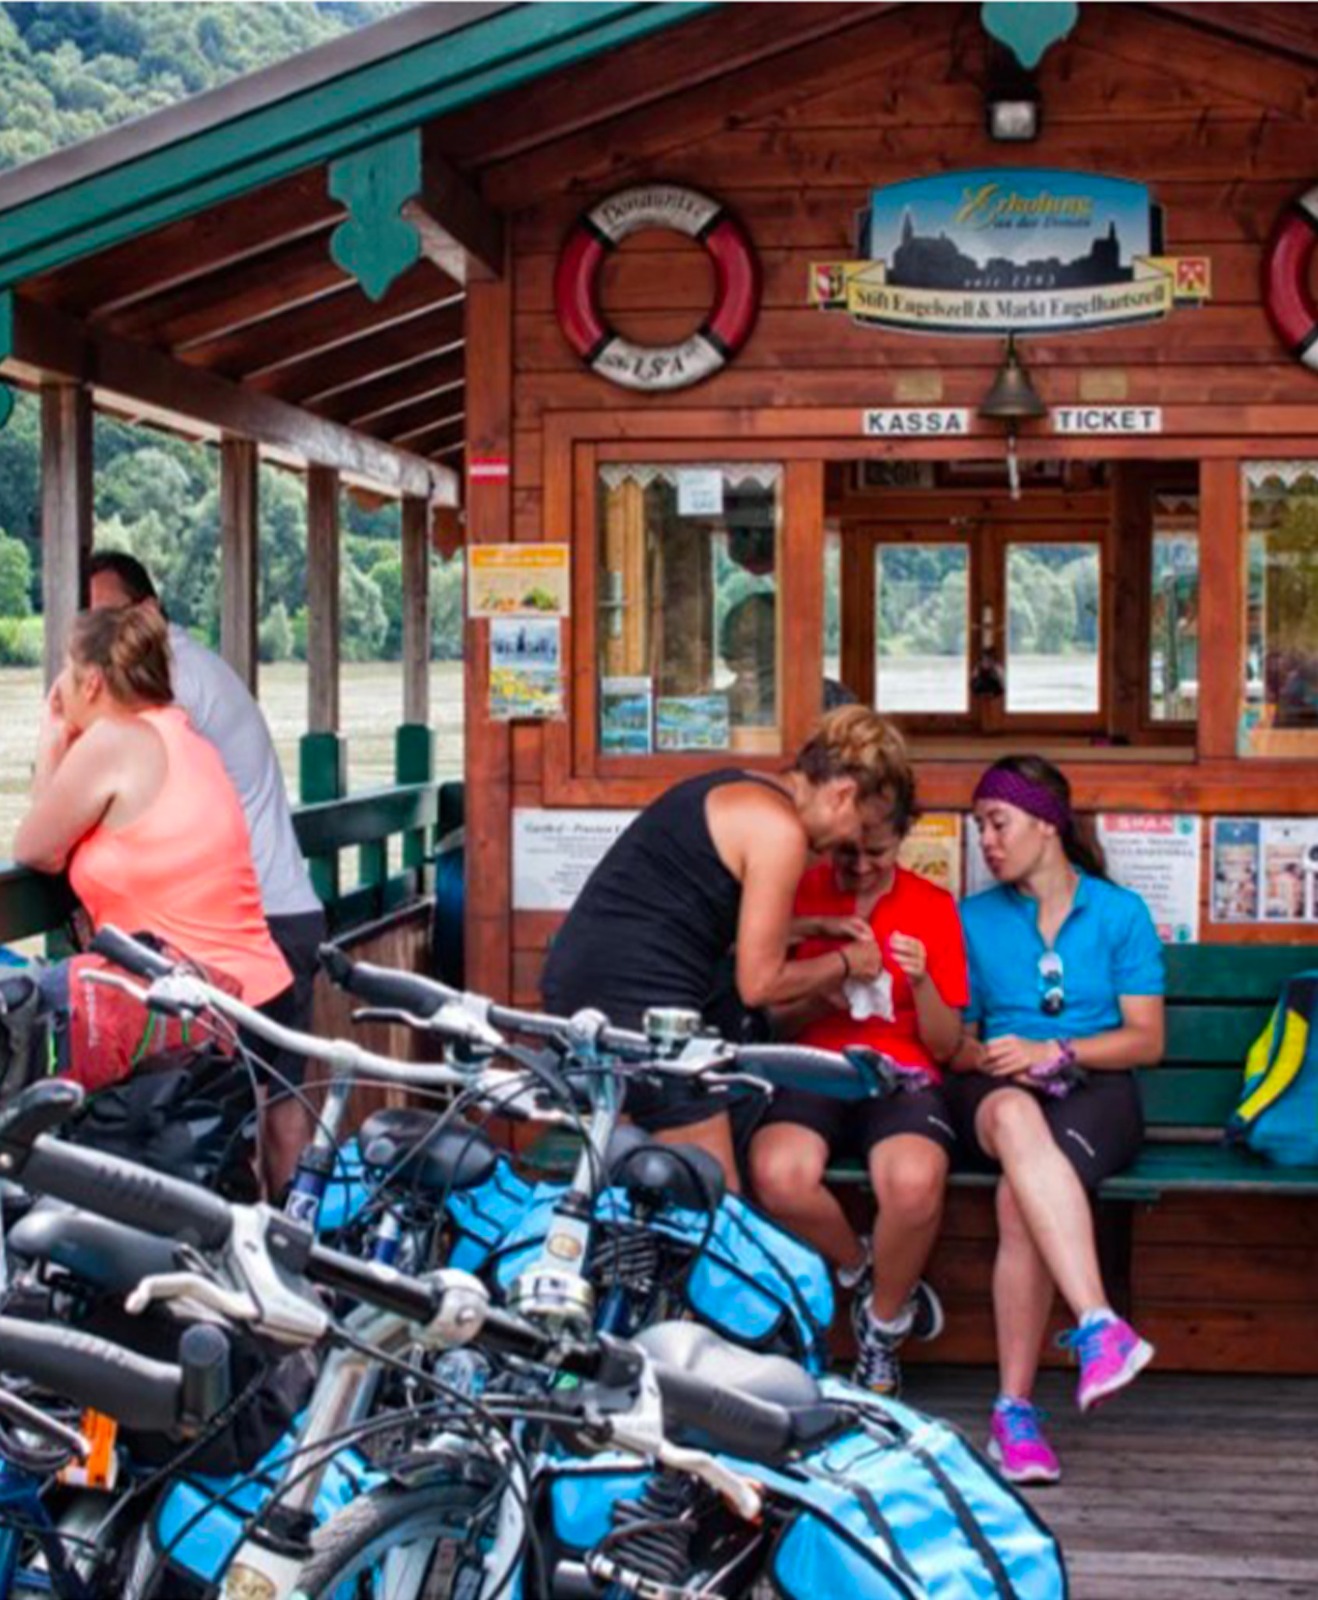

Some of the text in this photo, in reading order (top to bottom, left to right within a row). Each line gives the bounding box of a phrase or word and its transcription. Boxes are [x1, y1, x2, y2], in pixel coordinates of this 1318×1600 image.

[855, 286, 889, 310] Stift
[977, 299, 992, 318] &
[996, 298, 1046, 319] Markt
[867, 412, 962, 432] KASSA
[1059, 410, 1155, 429] TICKET
